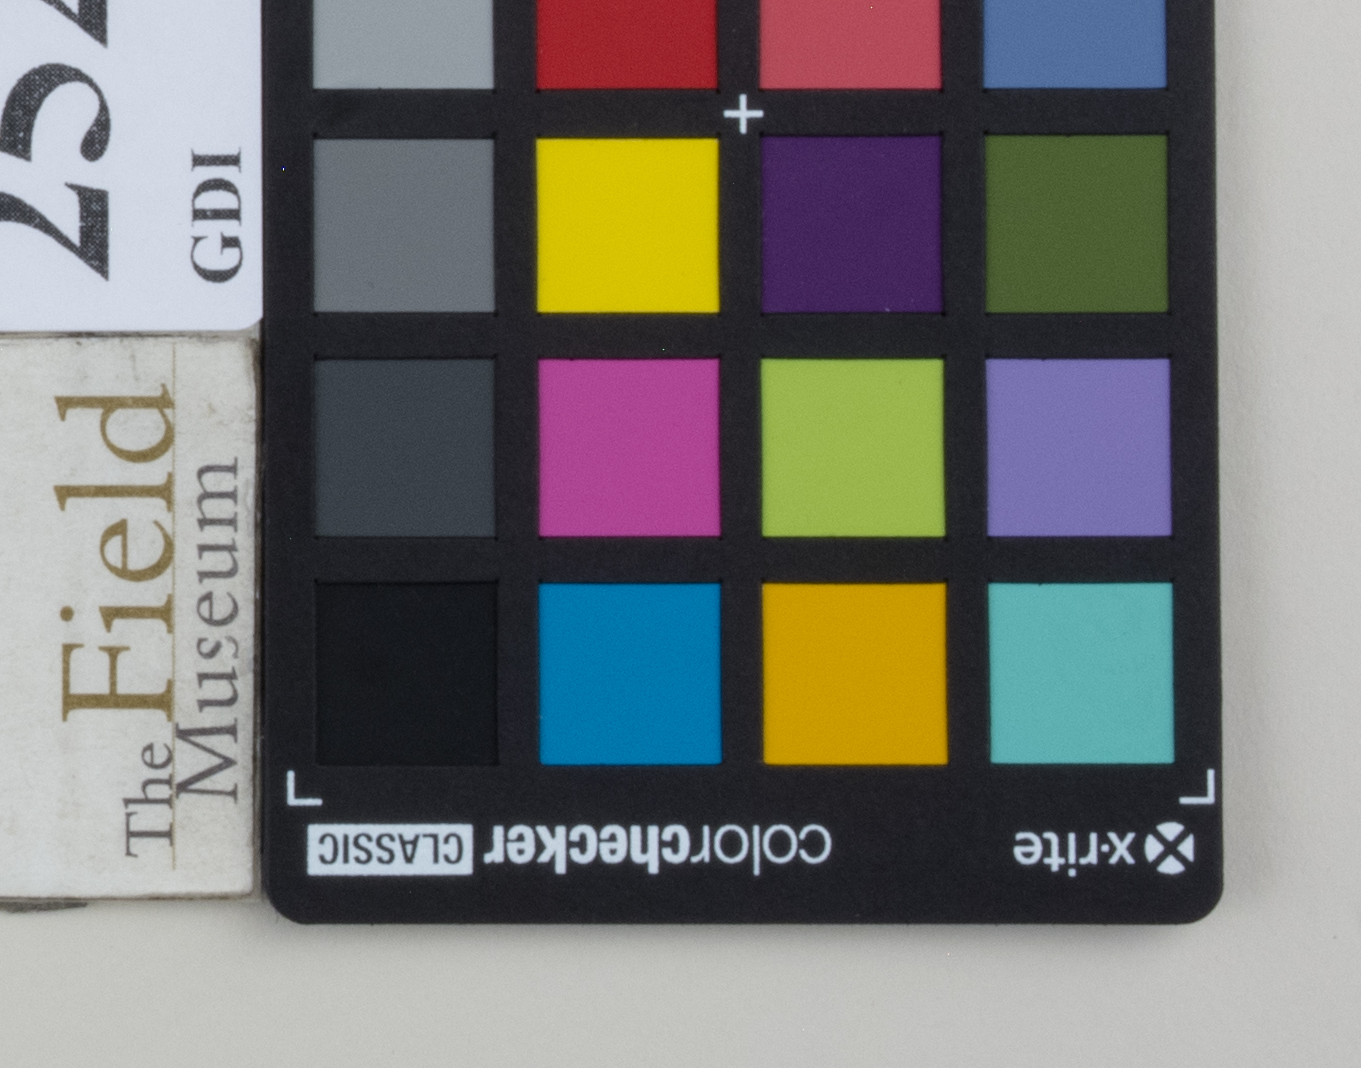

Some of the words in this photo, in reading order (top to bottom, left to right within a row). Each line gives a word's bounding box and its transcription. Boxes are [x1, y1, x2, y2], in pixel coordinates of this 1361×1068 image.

[190, 147, 243, 283] GDI
[53, 383, 175, 723] Field
[175, 456, 239, 804] Museum
[123, 741, 173, 858] The
[319, 833, 463, 865] CLASSIC
[483, 823, 832, 876] colorchecker
